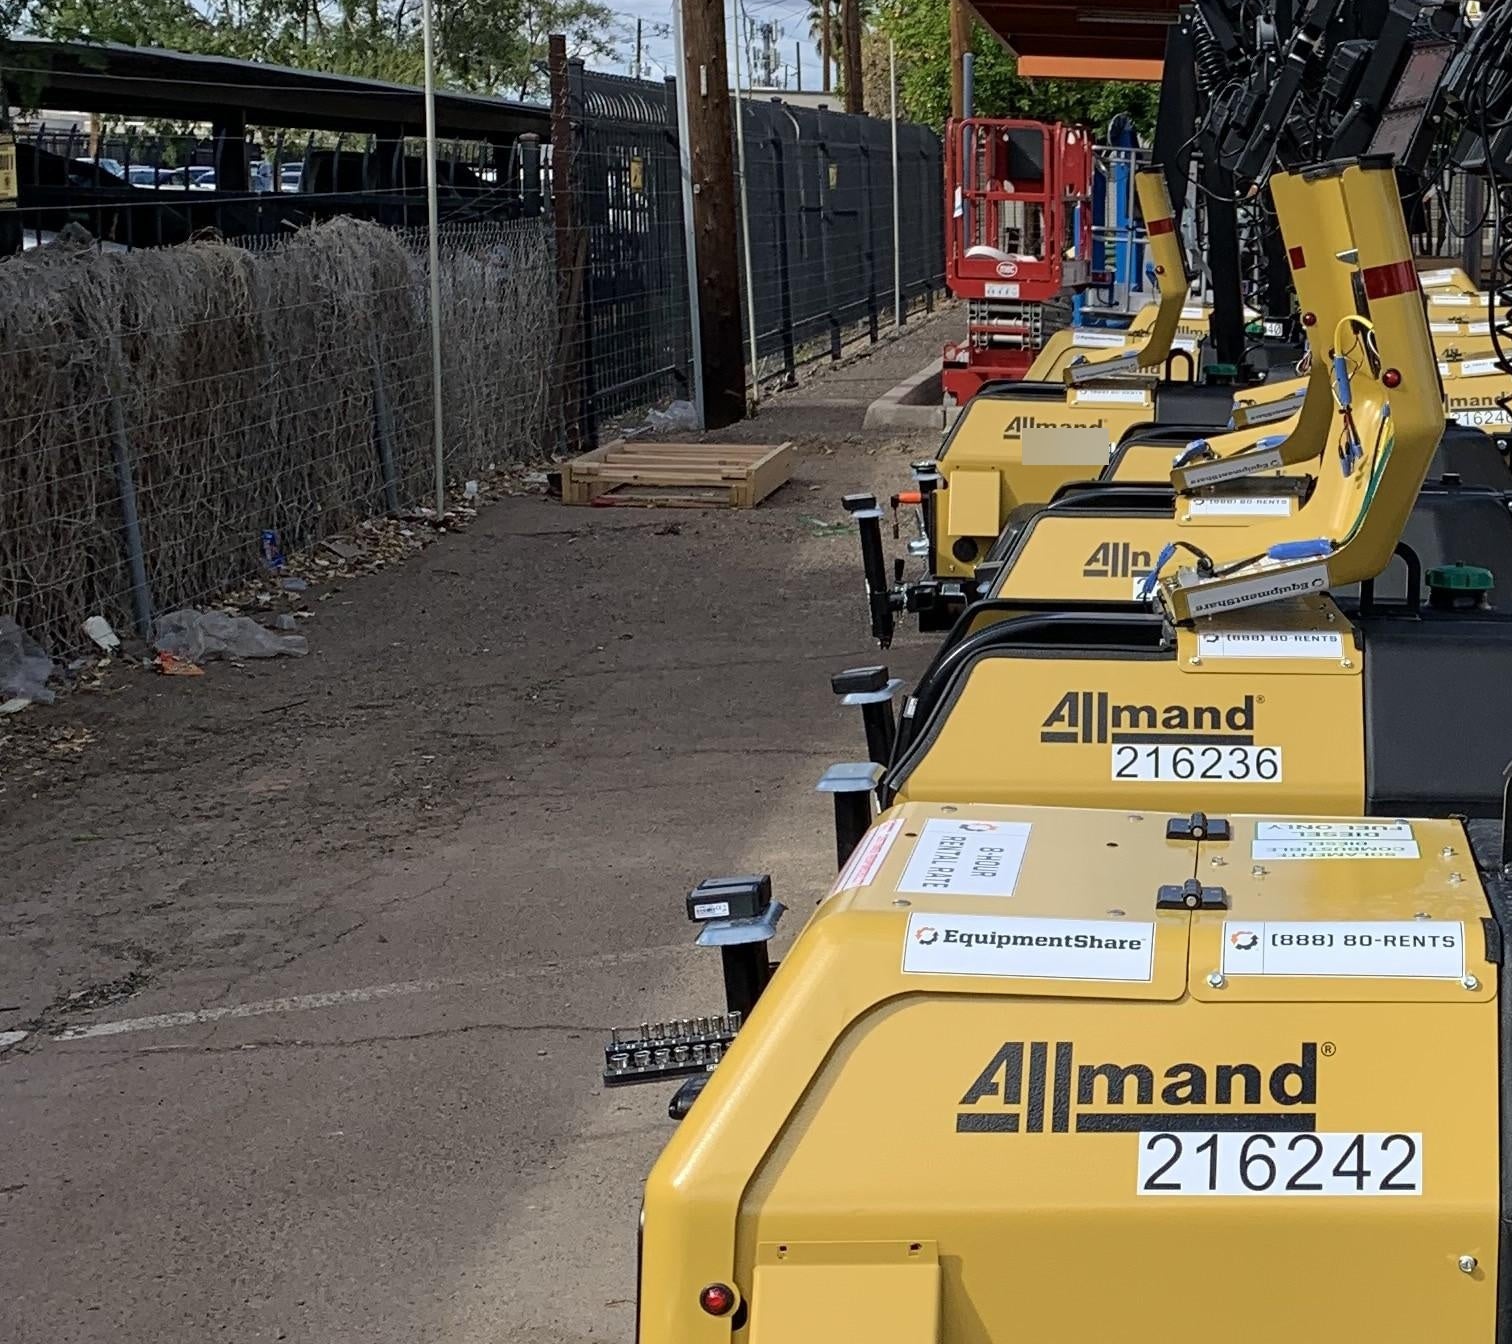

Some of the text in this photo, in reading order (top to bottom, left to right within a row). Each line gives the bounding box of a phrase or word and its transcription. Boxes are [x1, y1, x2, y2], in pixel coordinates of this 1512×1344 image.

[1195, 580, 1309, 612] EquipmentShare
[1040, 691, 1254, 745] Allmand
[1115, 746, 1278, 780] 216236
[922, 835, 967, 888] RENTAL RATE
[970, 846, 1004, 878] 8-HOUR
[943, 928, 1142, 951] EquipmentShare
[1271, 933, 1456, 948] (888) 80-RENTS
[957, 1041, 1317, 1133] Allmand
[1143, 1133, 1416, 1192] 216242
